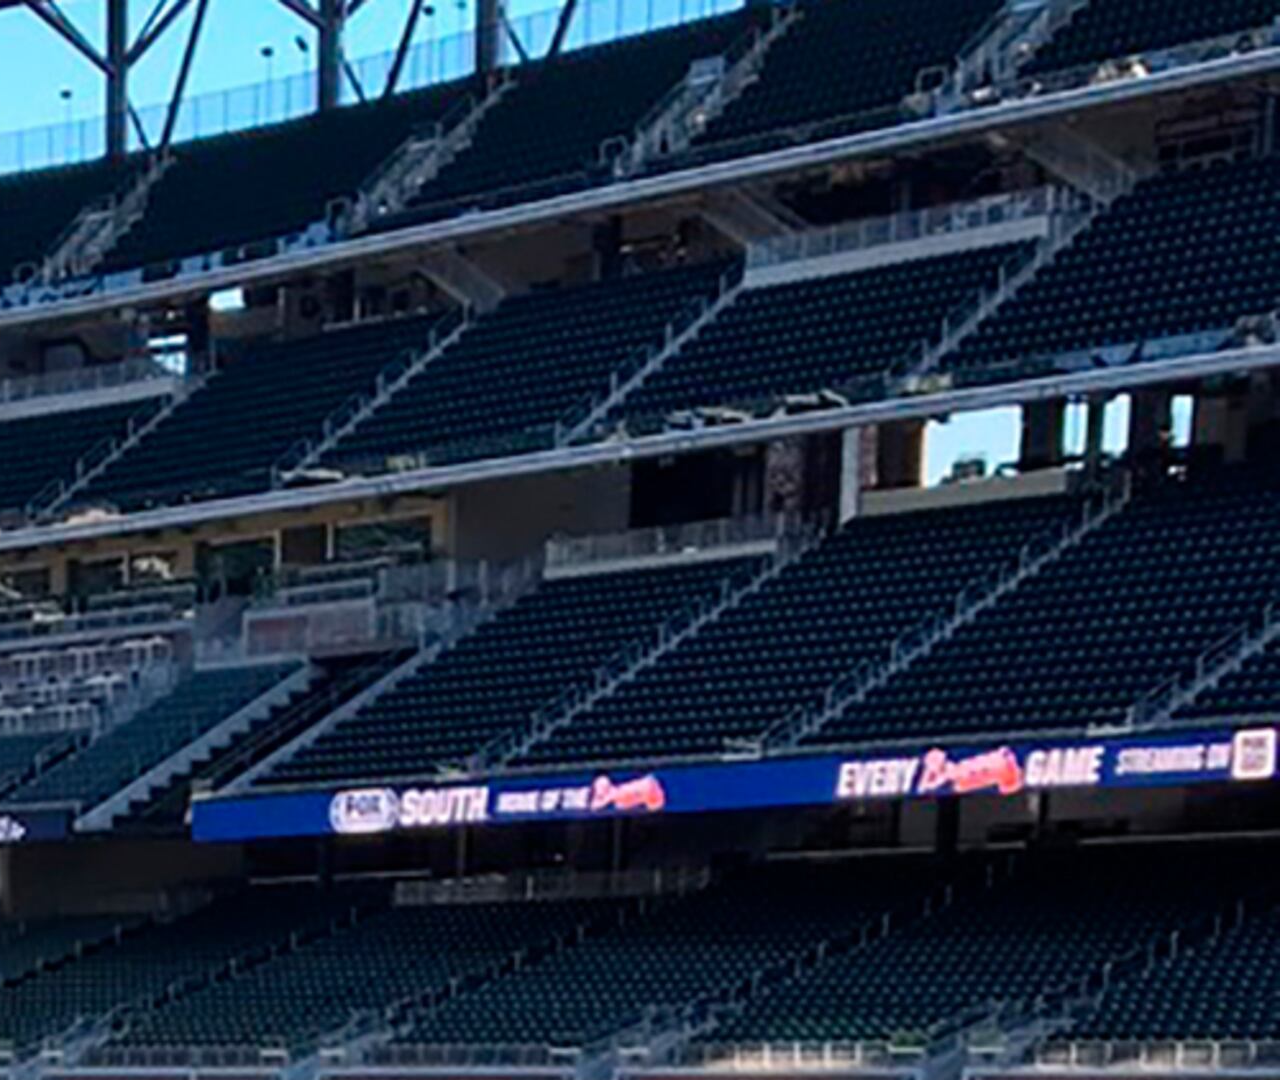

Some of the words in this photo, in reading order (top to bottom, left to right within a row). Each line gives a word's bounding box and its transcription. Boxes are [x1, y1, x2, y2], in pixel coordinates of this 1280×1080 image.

[836, 758, 920, 797] EVERY
[1025, 746, 1104, 786] GAME
[400, 785, 490, 826] SOUTH
